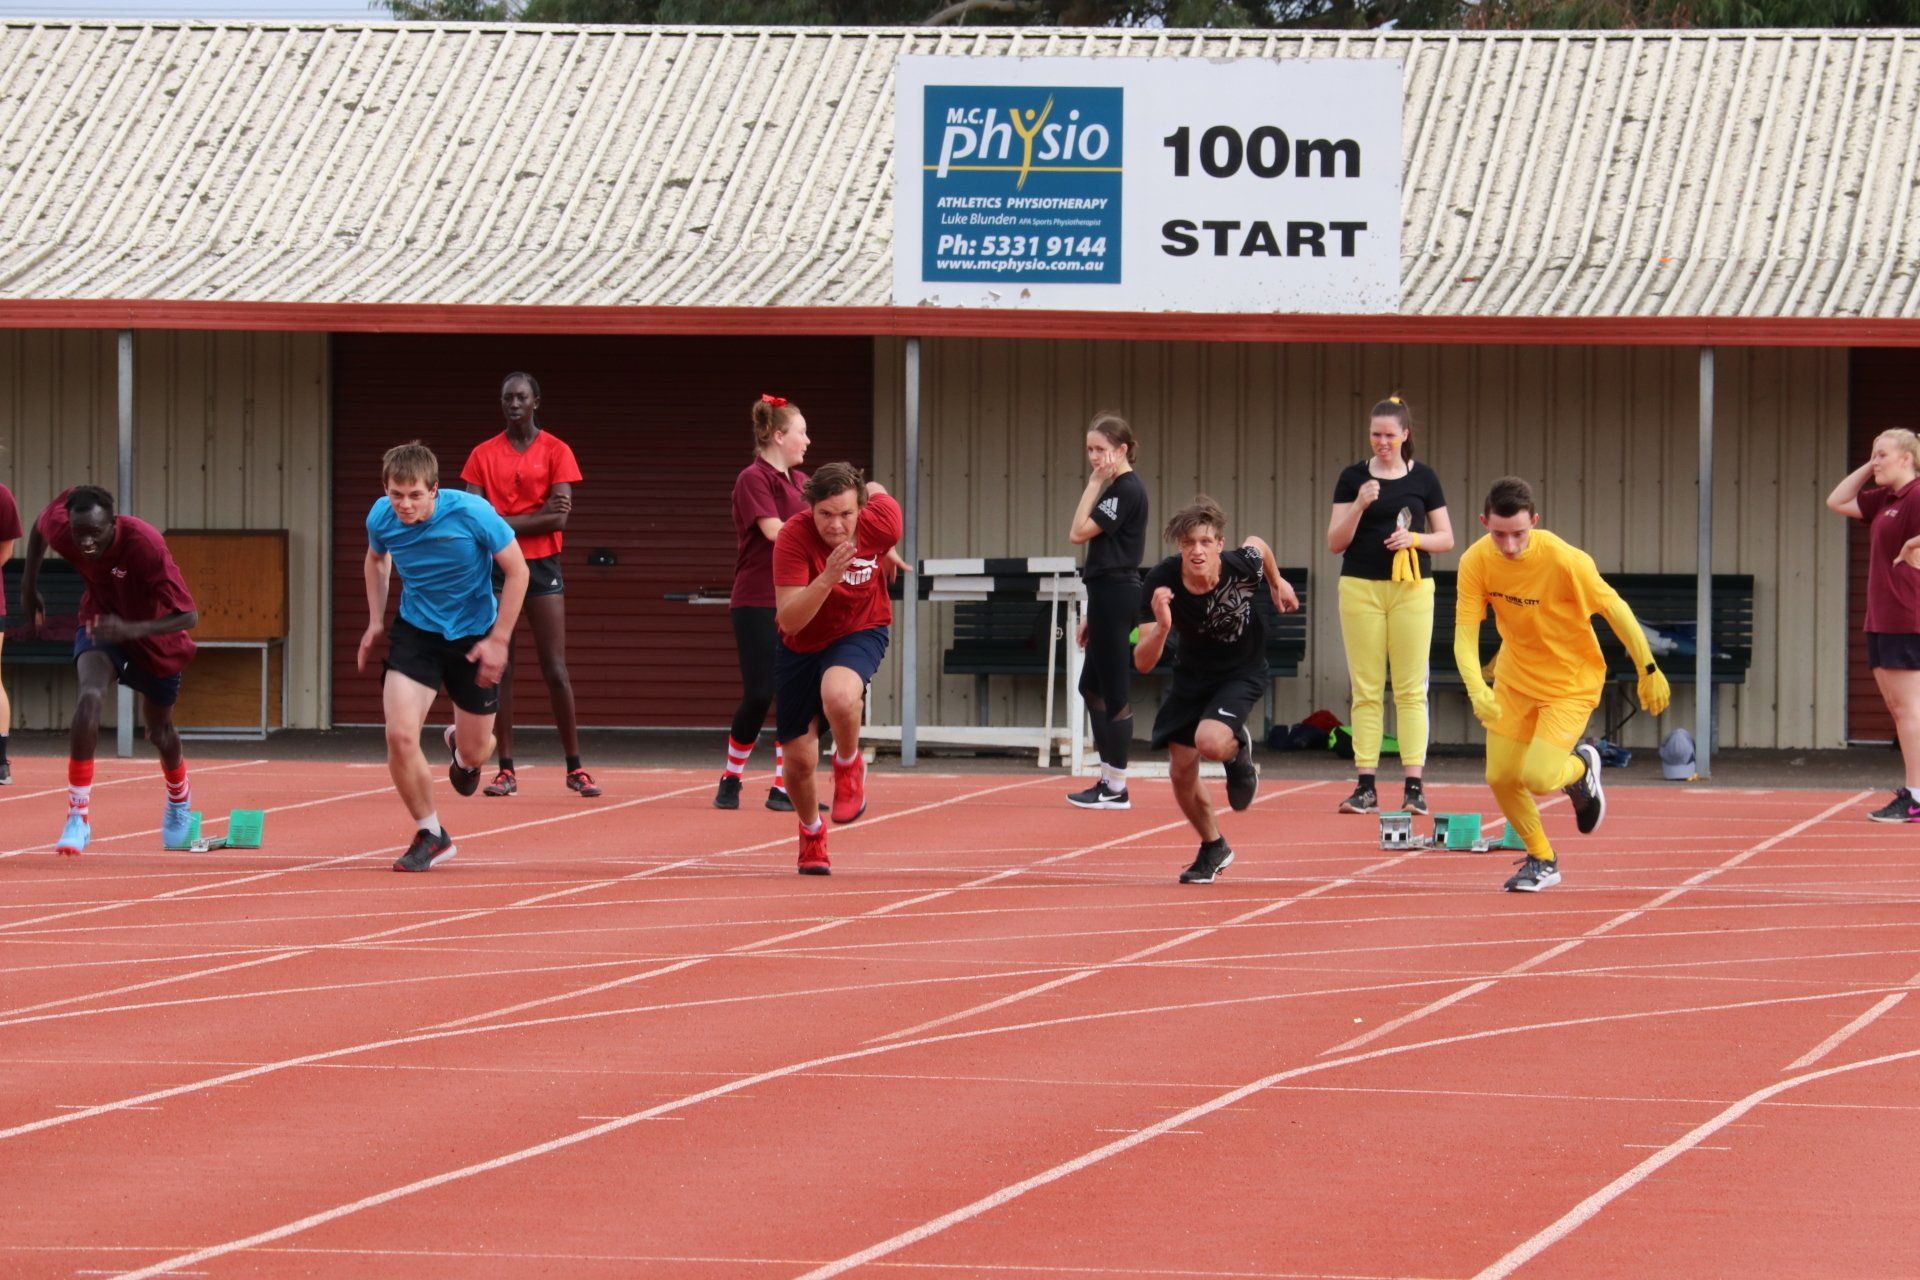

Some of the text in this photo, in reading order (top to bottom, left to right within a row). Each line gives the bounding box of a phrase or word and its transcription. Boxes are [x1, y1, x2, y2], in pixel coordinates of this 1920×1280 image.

[946, 107, 984, 124] M.C.
[936, 94, 1110, 191] physio
[1162, 125, 1362, 178] 100m
[936, 196, 1109, 210] ATHLETICS PHYSIOTHERAPY
[941, 212, 968, 225] Luke
[969, 213, 1017, 226] Blunden
[1032, 218, 1053, 227] Sports
[936, 234, 1107, 257] Ph: 5331 9144
[1160, 218, 1368, 258] START
[936, 257, 1105, 274] www.mcphysio.com.au
[1505, 595, 1523, 604] YORK
